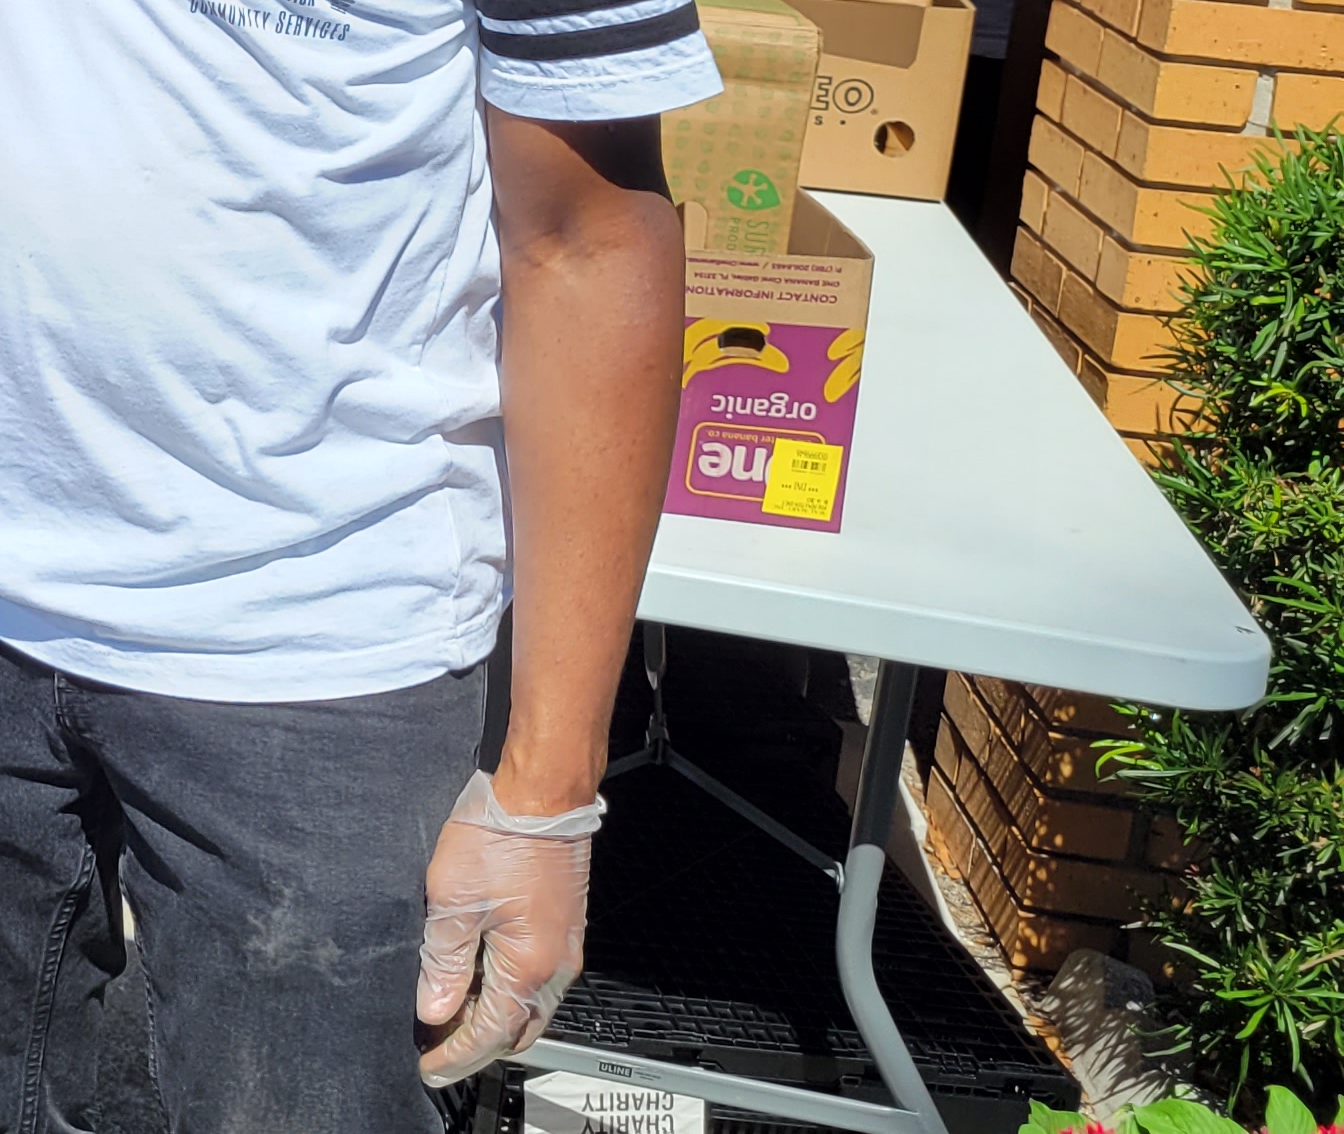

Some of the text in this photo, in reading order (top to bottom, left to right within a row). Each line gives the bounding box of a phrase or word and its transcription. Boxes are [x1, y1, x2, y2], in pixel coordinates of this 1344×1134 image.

[275, 10, 350, 41] SERVICES
[686, 286, 838, 304] CONTACT INFORMATION
[711, 392, 817, 420] organic
[722, 431, 758, 443] banana
[698, 442, 773, 486] ne
[601, 1063, 632, 1077] ULINE
[581, 1092, 674, 1112] CHARITY
[581, 1114, 674, 1134] CHARITY
